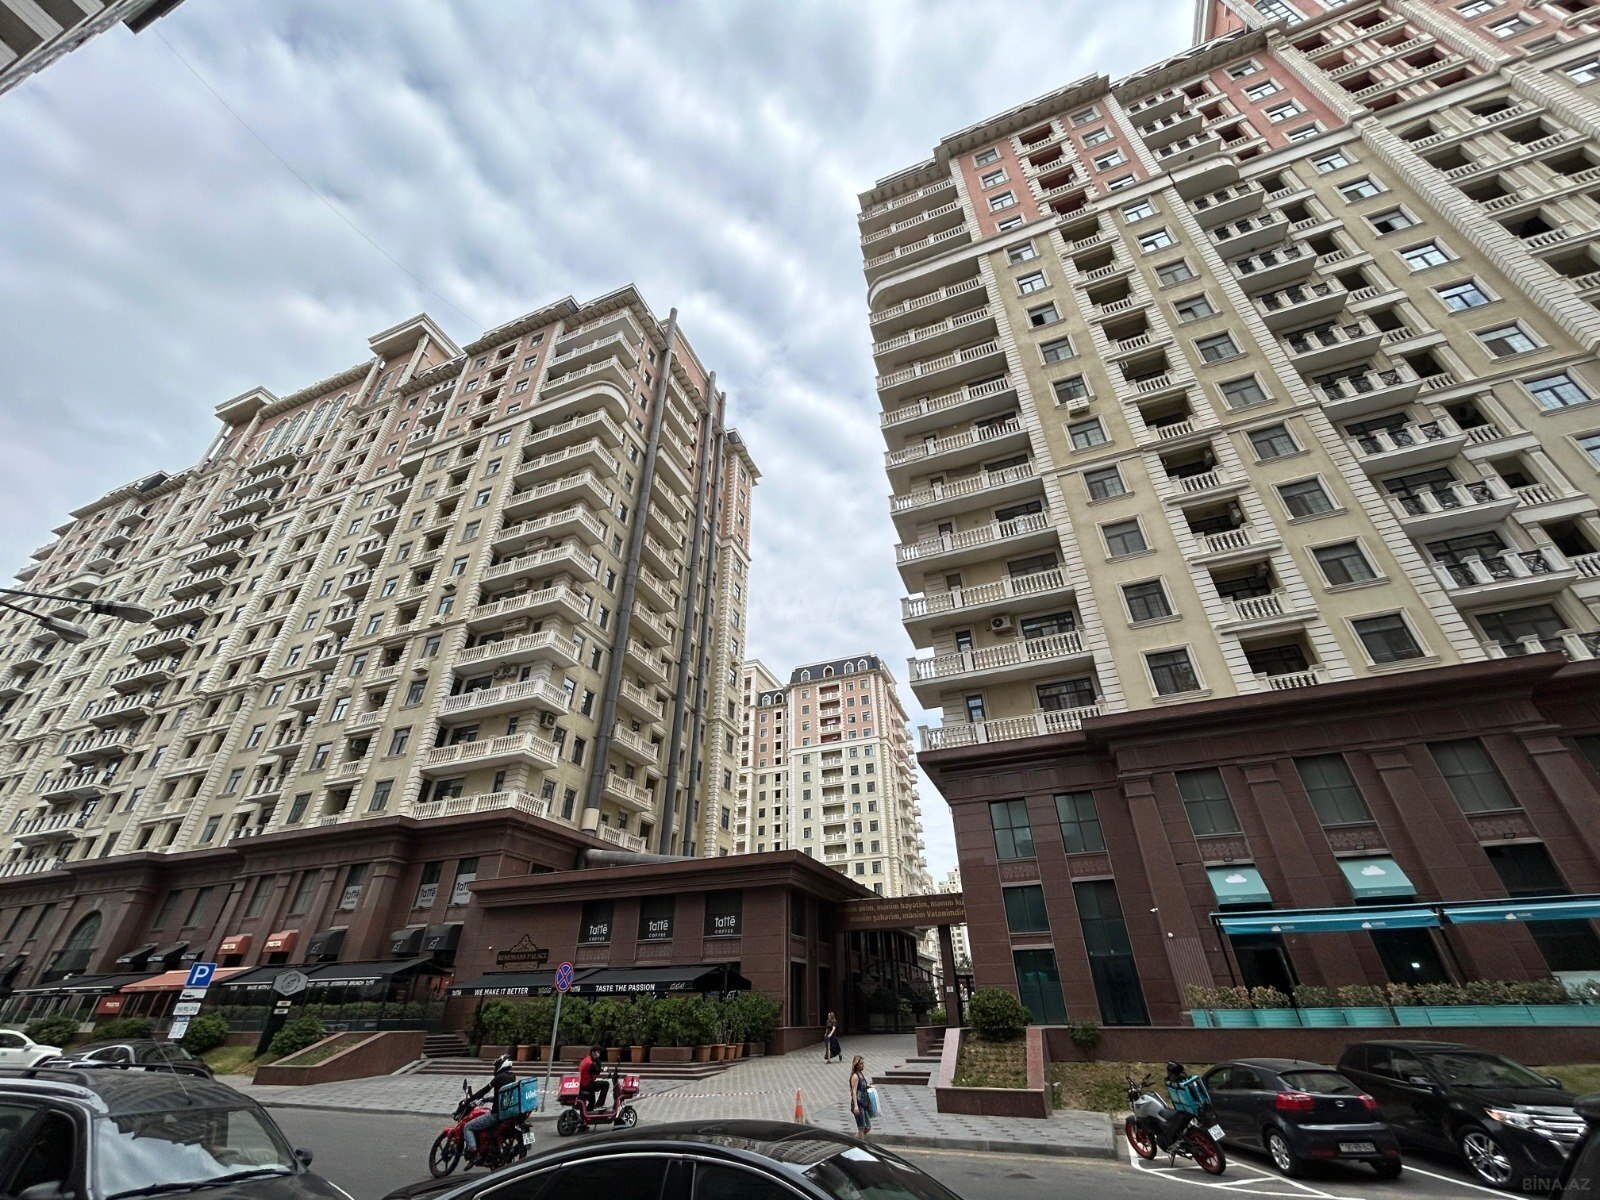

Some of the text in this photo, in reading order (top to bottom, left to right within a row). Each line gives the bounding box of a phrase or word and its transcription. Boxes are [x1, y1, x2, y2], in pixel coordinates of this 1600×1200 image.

[191, 965, 210, 984] P
[474, 988, 484, 996] WE
[507, 987, 529, 995] BETTER
[595, 983, 656, 992] TASTE THE PASSION
